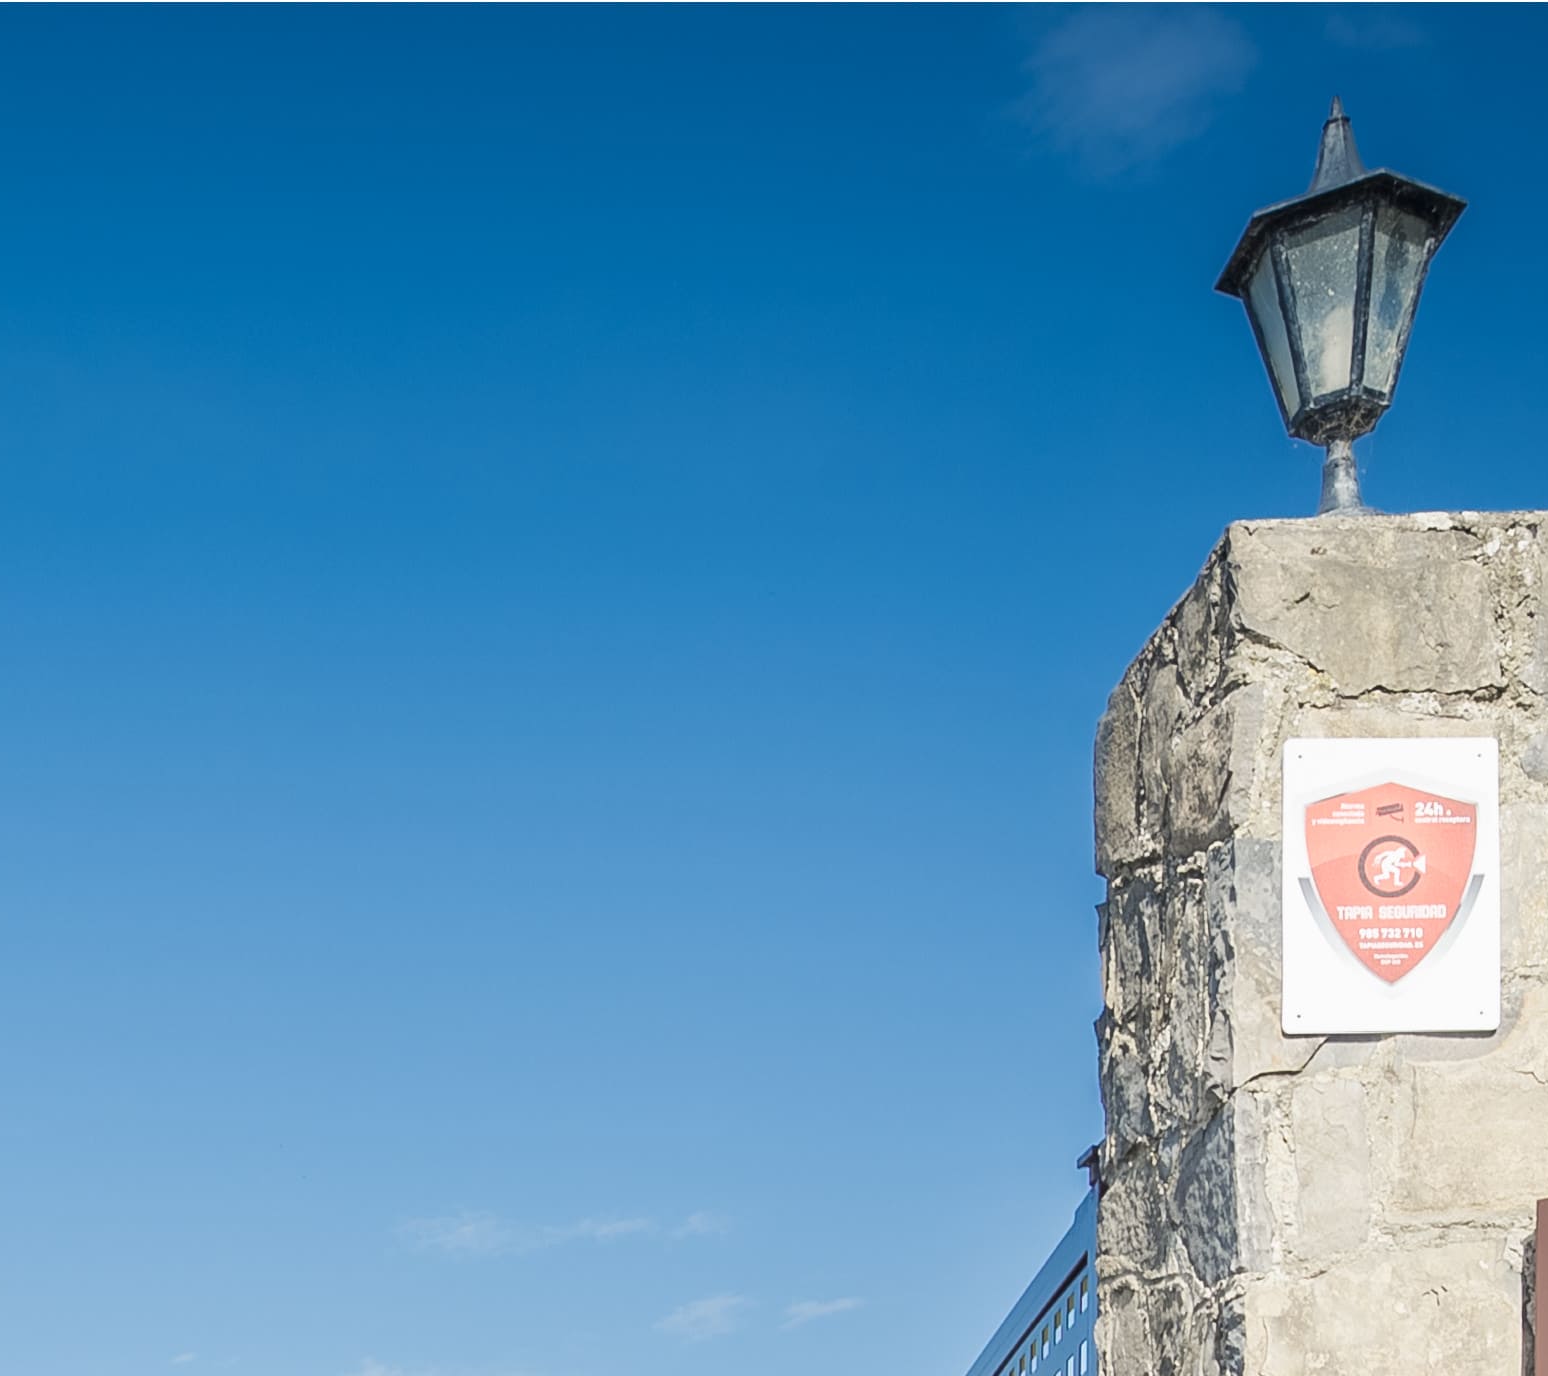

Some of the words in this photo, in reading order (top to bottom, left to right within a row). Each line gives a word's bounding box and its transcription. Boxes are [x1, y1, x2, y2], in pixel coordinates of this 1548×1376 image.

[1336, 905, 1373, 921] TAPIA
[1378, 904, 1447, 920] SEGURIDAD
[1359, 928, 1379, 940] 985
[1380, 928, 1401, 939] 732
[1402, 928, 1423, 939] 710
